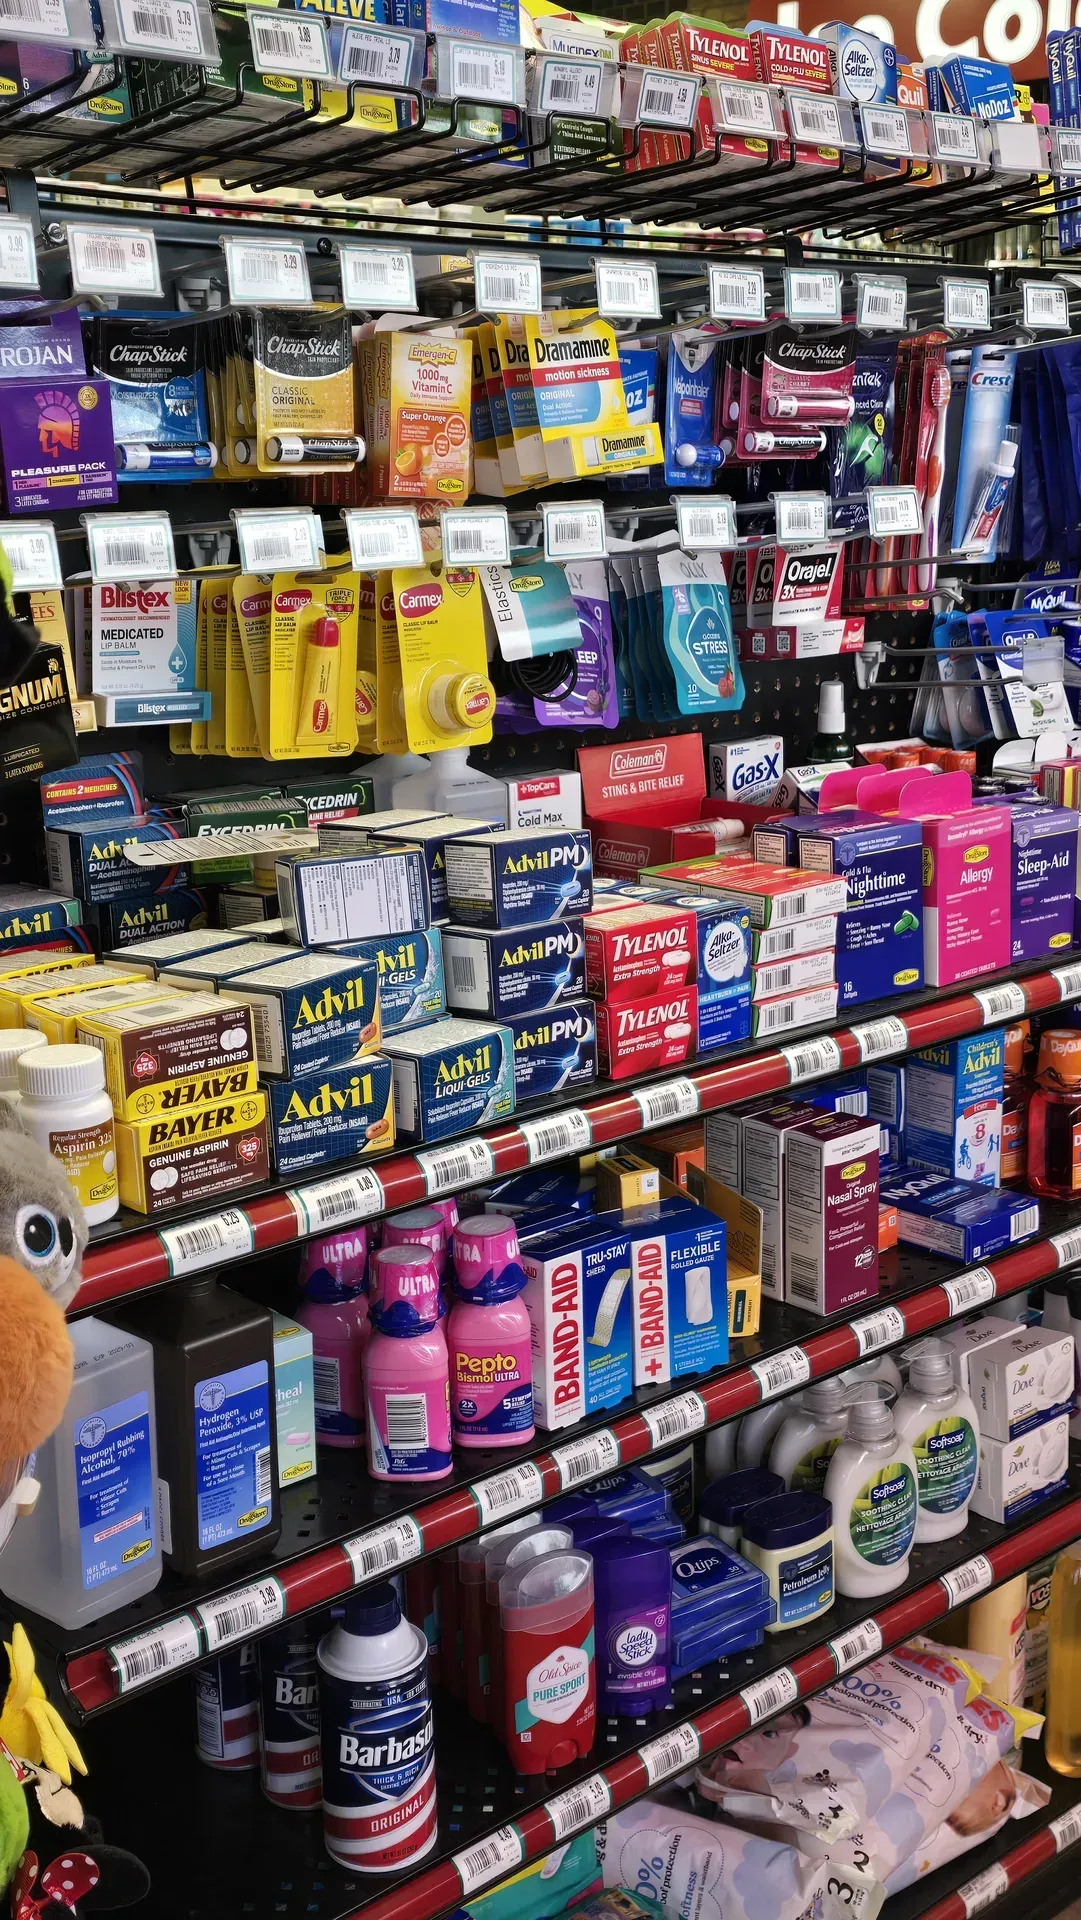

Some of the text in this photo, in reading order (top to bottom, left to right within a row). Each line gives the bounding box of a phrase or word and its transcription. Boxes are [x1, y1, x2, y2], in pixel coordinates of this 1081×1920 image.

[177, 10, 192, 26] 3.79
[298, 26, 311, 43] 3.89
[686, 29, 749, 62] TYLENOL
[767, 36, 826, 68] TYLENOL
[389, 48, 400, 63] 3.79
[691, 54, 734, 71] SINUS SEVERE
[1050, 42, 1062, 85] NyQuil
[23, 78, 29, 89] 6
[805, 69, 826, 80] SEVERE
[978, 99, 1009, 120] NoDoz
[8, 235, 23, 252] 3.99
[284, 254, 297, 269] 3.29
[392, 257, 404, 272] 3.29
[110, 345, 187, 363] ChapStick
[267, 336, 340, 356] ChapStick
[413, 347, 455, 361] Emergen-C
[535, 337, 610, 363] Dramamine
[778, 342, 846, 359] ChapStick
[545, 367, 609, 381] motion sickness
[972, 371, 1011, 387] Crest
[272, 386, 308, 396] CLASSIC
[540, 389, 575, 400] ORIGINAL
[273, 396, 315, 406] ORIGINAL
[401, 411, 447, 424] Super Orange
[602, 436, 645, 452] Dramamine
[11, 461, 106, 477] PLEASURE PACK
[680, 562, 707, 578] OLLY
[101, 587, 169, 614] Blistex
[275, 595, 311, 606] Carmex
[400, 592, 442, 610] Carmex
[487, 566, 512, 622] Elastics
[781, 587, 796, 600] 3X
[101, 628, 163, 640] MEDICATED
[115, 641, 136, 649] BALM
[693, 641, 728, 655] STRESS
[688, 684, 697, 693] 10
[138, 704, 166, 714] Blistex
[614, 754, 654, 770] Coleman
[732, 752, 780, 790] Gas-X
[46, 783, 117, 798] CONTAINS 2 MEDICINES
[527, 781, 557, 792] TopCare
[602, 775, 684, 798] STING & BITE RELIEF
[518, 813, 562, 827] Cold Max
[502, 845, 579, 875] Advil PM
[1018, 852, 1069, 876] Sleep-Aid
[960, 866, 993, 885] Allergy
[119, 904, 168, 927] Advil
[120, 919, 185, 939] DUAL ACTION
[612, 927, 687, 961] TYLENOL
[710, 930, 735, 949] Alka-
[1013, 940, 1021, 950] 24
[708, 938, 740, 961] Seltzer
[614, 965, 660, 981] Extra Strength
[844, 982, 852, 992] 16
[293, 977, 364, 1029] Advil
[617, 999, 689, 1036] TYLENOL
[168, 1050, 248, 1075] GENUINE ASPIRIN
[434, 1045, 490, 1086] Advil
[963, 1046, 1000, 1075] Advil
[162, 1071, 248, 1108] BAYER
[280, 1074, 374, 1124] Advil
[53, 1129, 101, 1141] Regular Strength
[149, 1106, 235, 1145] BAYER
[278, 1125, 302, 1137] Ibuprofen
[323, 1116, 332, 1125] 200
[334, 1115, 342, 1123] mg
[279, 1133, 290, 1143] Pain
[329, 1121, 348, 1132] Reducer
[349, 1116, 368, 1128] (NSAID)
[54, 1135, 112, 1156] Aspirin 325
[149, 1139, 229, 1168] GENUINE ASPIRIN
[241, 1142, 258, 1151] 325
[827, 1181, 877, 1207] Nasal Spray
[222, 1213, 240, 1226] 6.29
[323, 1238, 363, 1264] ULTRA
[586, 1243, 627, 1266] TRU-STAY
[671, 1241, 720, 1261] FLEXIBLE
[586, 1265, 605, 1277] SHEER
[671, 1255, 714, 1270] ROLLED GAUZE
[399, 1275, 435, 1297] ULTRA
[638, 1243, 665, 1349] BAND-AID
[552, 1263, 580, 1406] BAND-AID
[456, 1353, 516, 1375] Pepto
[457, 1371, 520, 1382] Bismol ULTRA
[1012, 1376, 1034, 1396] Dove
[503, 1398, 511, 1409] 5
[1013, 1401, 1032, 1416] original
[200, 1408, 239, 1427] Hydrogen
[200, 1408, 264, 1438] Peroxide, 3% USP
[80, 1430, 145, 1464] Isopropyl Rubbing
[930, 1431, 964, 1449] Softsoap
[81, 1446, 135, 1475] Alcohol, 70%
[873, 1479, 905, 1499] Softsoap
[856, 1517, 895, 1532] NETTOYAGE
[783, 1565, 831, 1592] Petroleum Jelly
[260, 1586, 276, 1605] 3.89
[620, 1635, 653, 1655] Speed
[627, 1630, 648, 1645] lady
[626, 1645, 650, 1662] Stick
[538, 1661, 582, 1684] Old Spice
[617, 1670, 657, 1680] invisible dry
[533, 1673, 586, 1702] PURE SPORT
[387, 1695, 401, 1706] USA
[872, 1700, 916, 1733] protection
[340, 1709, 434, 1767] Barbasol
[373, 1776, 393, 1785] THICK
[405, 1767, 419, 1779] RICH
[371, 1795, 424, 1833] ORIGINAL
[853, 1850, 869, 1873] 2
[828, 1878, 854, 1904] 3
